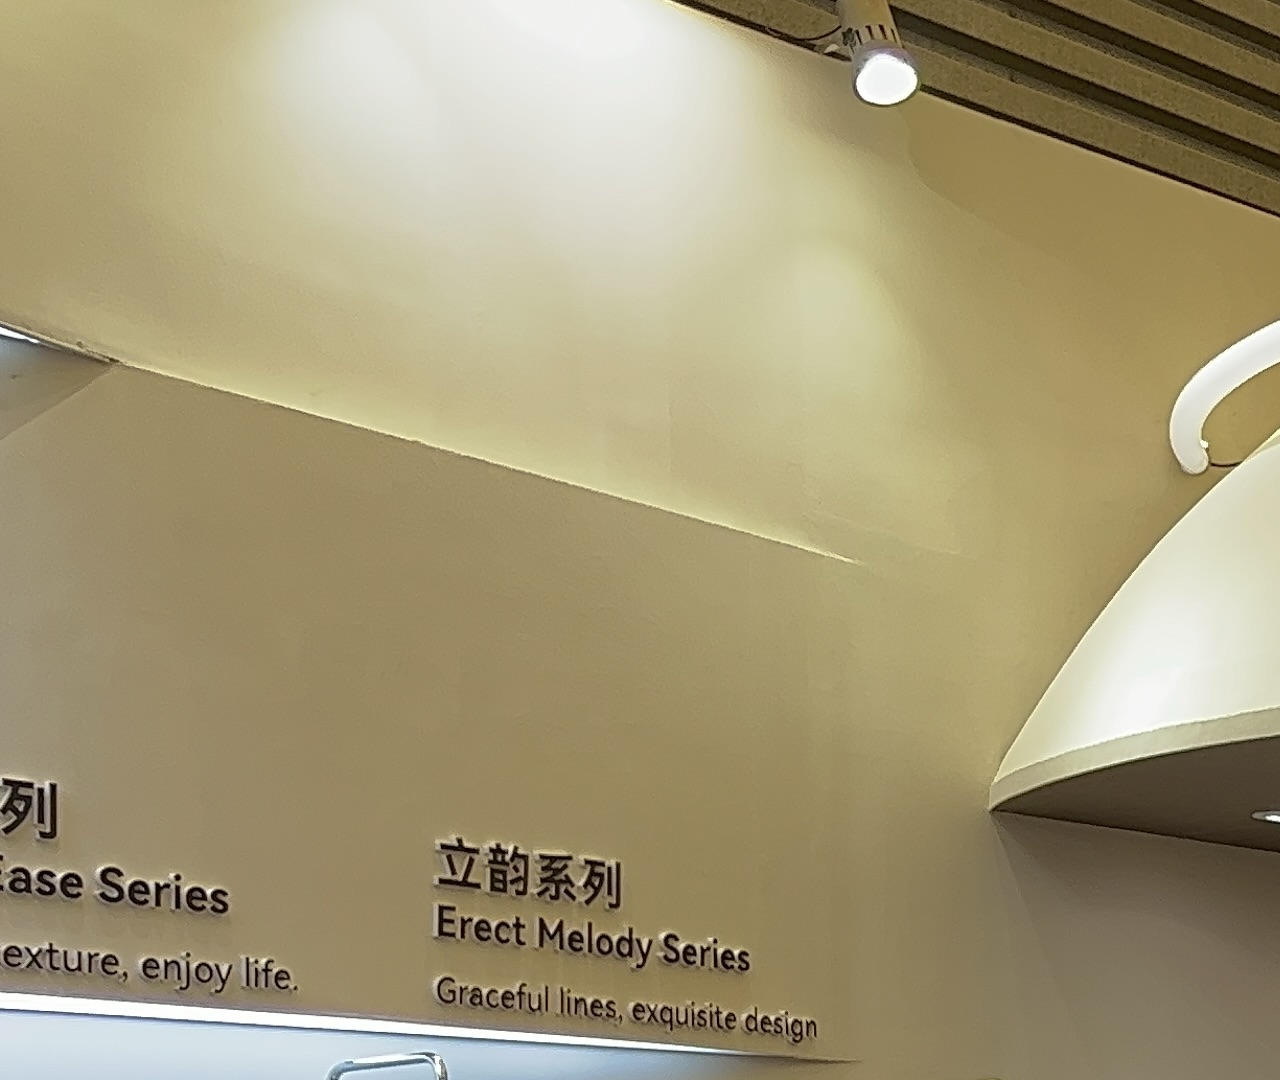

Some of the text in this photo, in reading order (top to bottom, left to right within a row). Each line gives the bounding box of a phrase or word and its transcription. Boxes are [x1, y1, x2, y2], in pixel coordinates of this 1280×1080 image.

[1, 777, 58, 839] 列
[99, 866, 229, 914] Series
[437, 836, 622, 909] 立韵系列
[0, 943, 299, 993] exture, enjoy life.
[437, 904, 751, 972] Erect Melody Series
[437, 976, 817, 1043] Graceful lines, exquisite design
